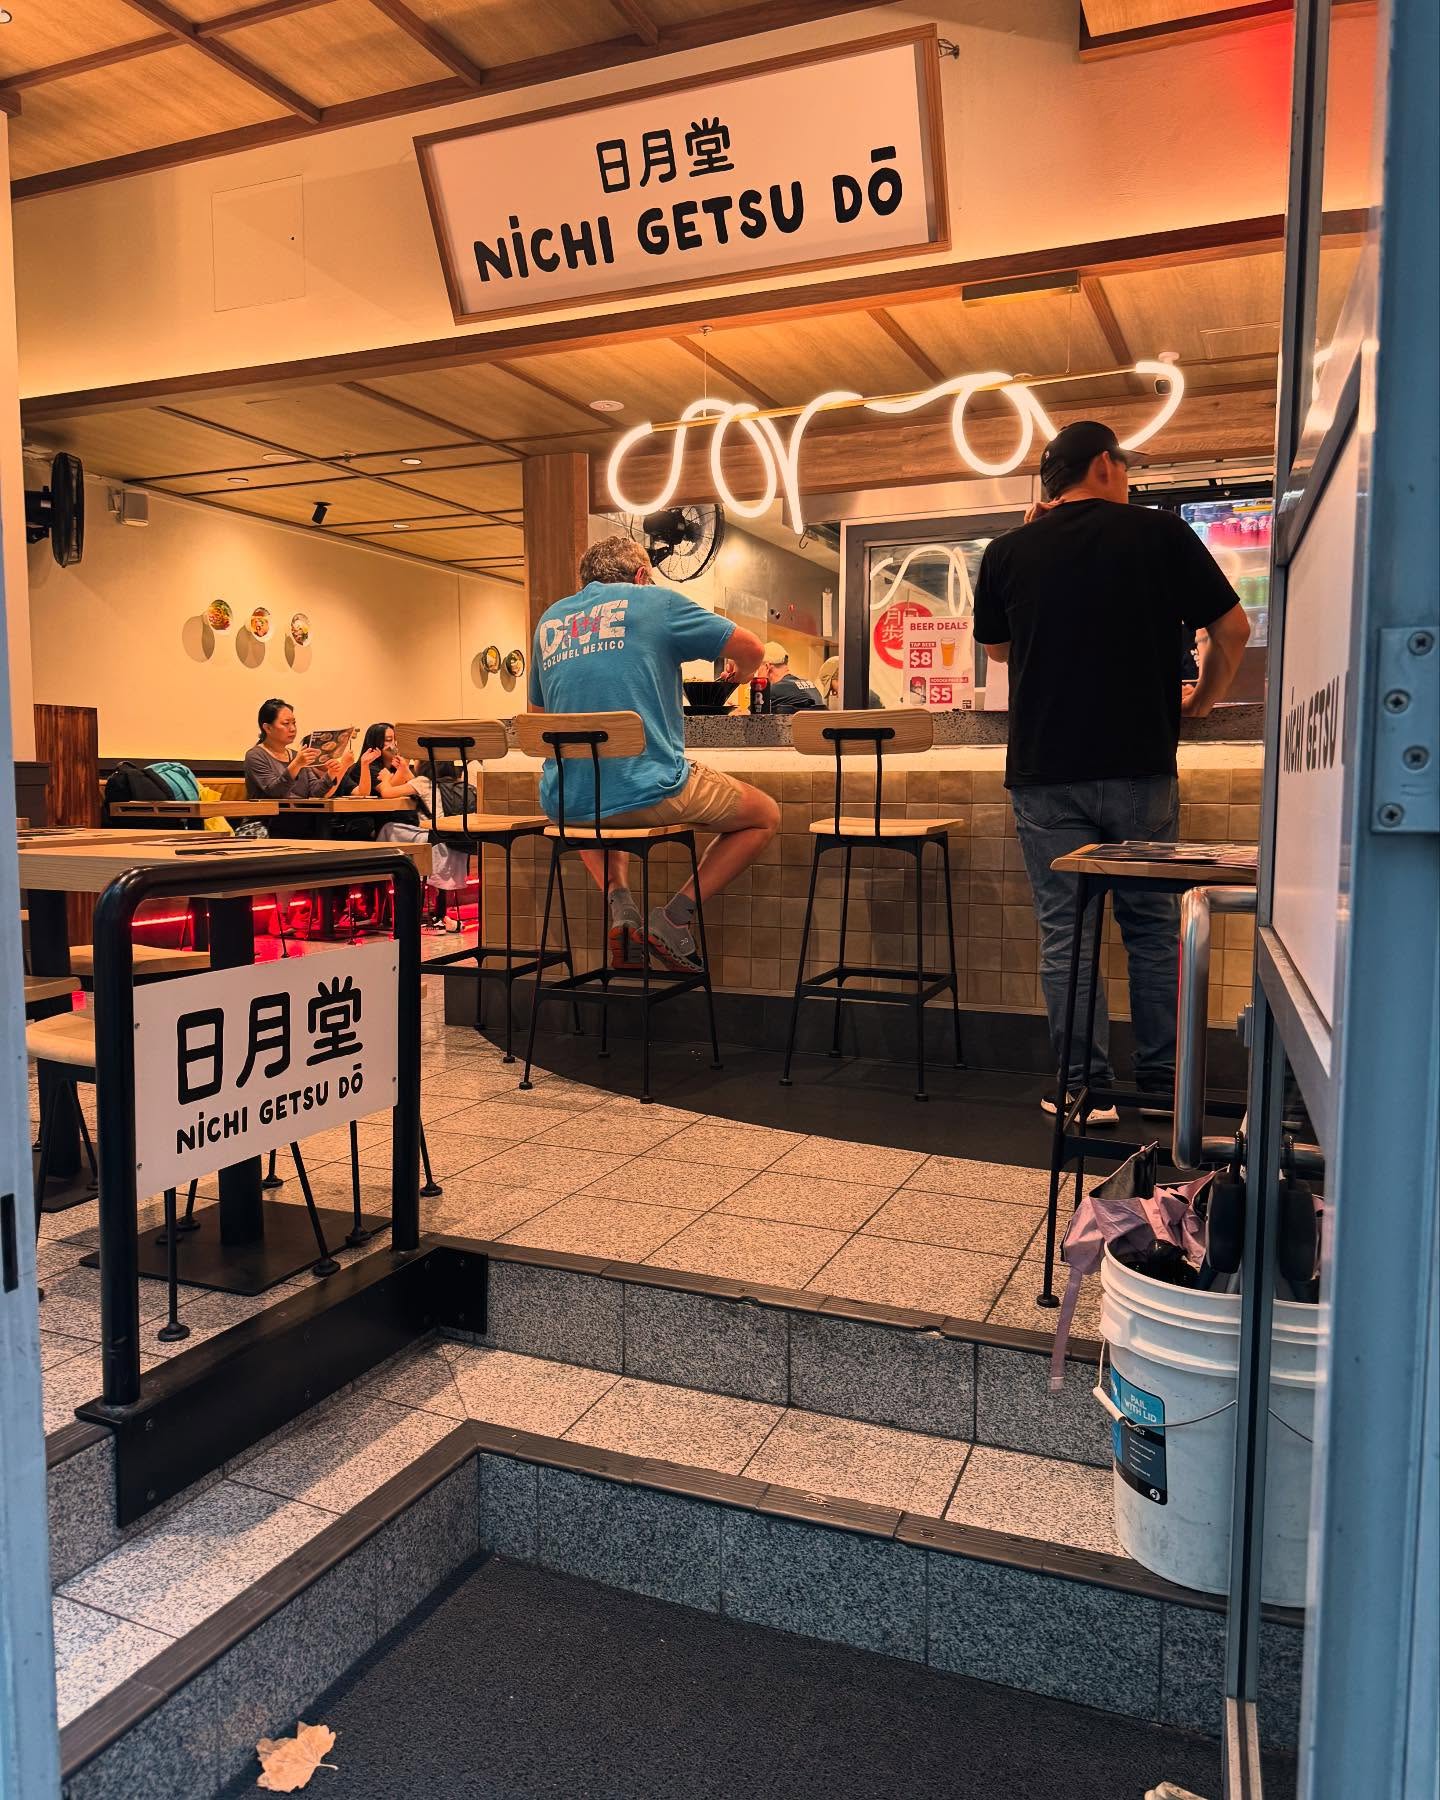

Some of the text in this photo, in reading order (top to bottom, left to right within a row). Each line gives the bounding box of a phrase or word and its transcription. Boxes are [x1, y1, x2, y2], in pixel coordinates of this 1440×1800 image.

[596, 117, 735, 193] 日月堂
[638, 180, 804, 255] GETSU
[910, 622, 968, 631] BEER DEALS
[543, 640, 625, 671] COZUMEL MEXICO
[910, 651, 932, 668] $8
[930, 685, 952, 703] $5
[1306, 675, 1340, 772] GETSU
[177, 975, 363, 1105] 日月堂
[259, 1080, 329, 1124] GETSU
[1124, 1399, 1157, 1424] WITH LID
[1130, 1394, 1147, 1410] PAIL
